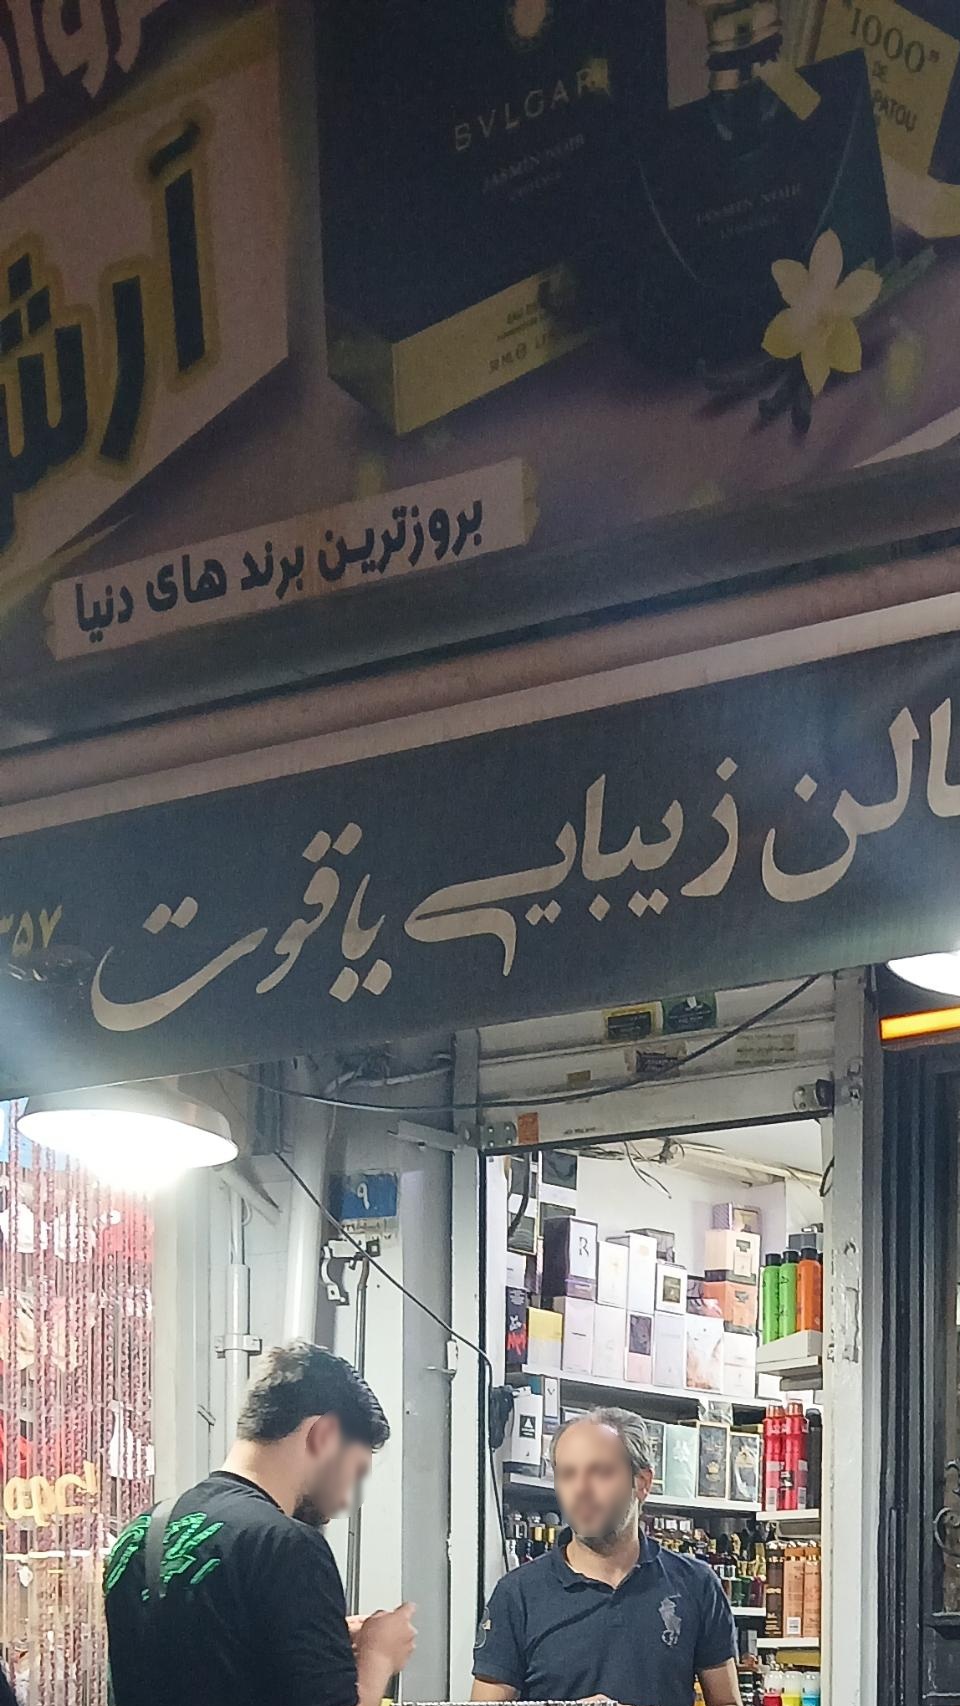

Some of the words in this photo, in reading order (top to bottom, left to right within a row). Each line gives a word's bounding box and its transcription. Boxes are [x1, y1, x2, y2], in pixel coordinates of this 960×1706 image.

[146, 553, 227, 612] های
[240, 539, 304, 599] برند
[75, 582, 134, 643] دنیا
[404, 756, 739, 976] زیبایی
[91, 822, 393, 1032] یاقوت
